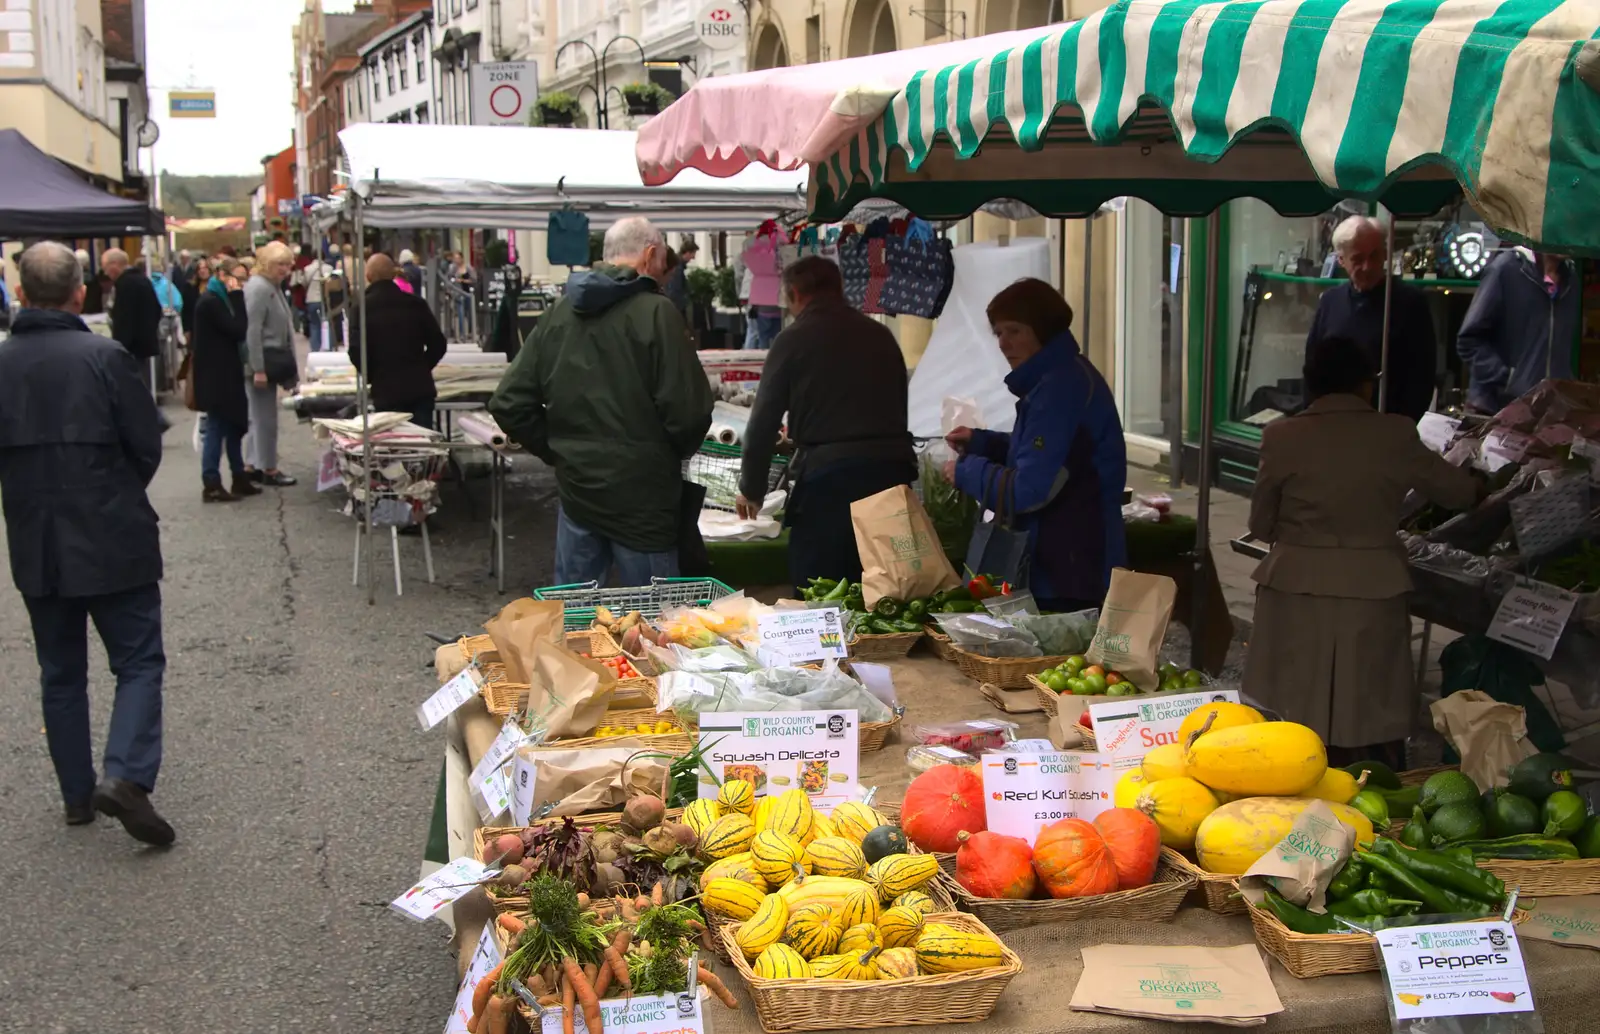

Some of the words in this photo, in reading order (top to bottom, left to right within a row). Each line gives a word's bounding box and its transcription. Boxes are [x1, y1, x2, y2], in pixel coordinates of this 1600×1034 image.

[702, 23, 741, 37] HSBC
[490, 72, 519, 81] ZONE
[1539, 602, 1558, 615] Policy
[763, 627, 814, 639] Courgettes
[1155, 702, 1171, 711] WILD
[1173, 697, 1204, 708] COUNTRY
[1157, 706, 1197, 720] ORGANI
[762, 717, 780, 725] WILD
[782, 716, 815, 724] COUNTRY
[763, 725, 814, 736] ORGANICS
[1105, 719, 1137, 752] Spaghetti
[1140, 728, 1180, 747] Squ
[713, 751, 774, 763] Squash
[1039, 755, 1058, 763] WILD
[1004, 790, 1037, 801] Red
[1069, 789, 1099, 800] Squash
[1034, 811, 1061, 819] £3.00
[1288, 833, 1337, 861] GANICS
[1435, 938, 1480, 948] ORGANICS
[1418, 953, 1507, 969] Peppers
[1140, 984, 1222, 994] ORGANICS
[1433, 992, 1460, 1000] £0.75
[1469, 990, 1488, 998] 100g
[632, 1001, 666, 1011] COUNTRY
[613, 1011, 666, 1026] ORGANICS
